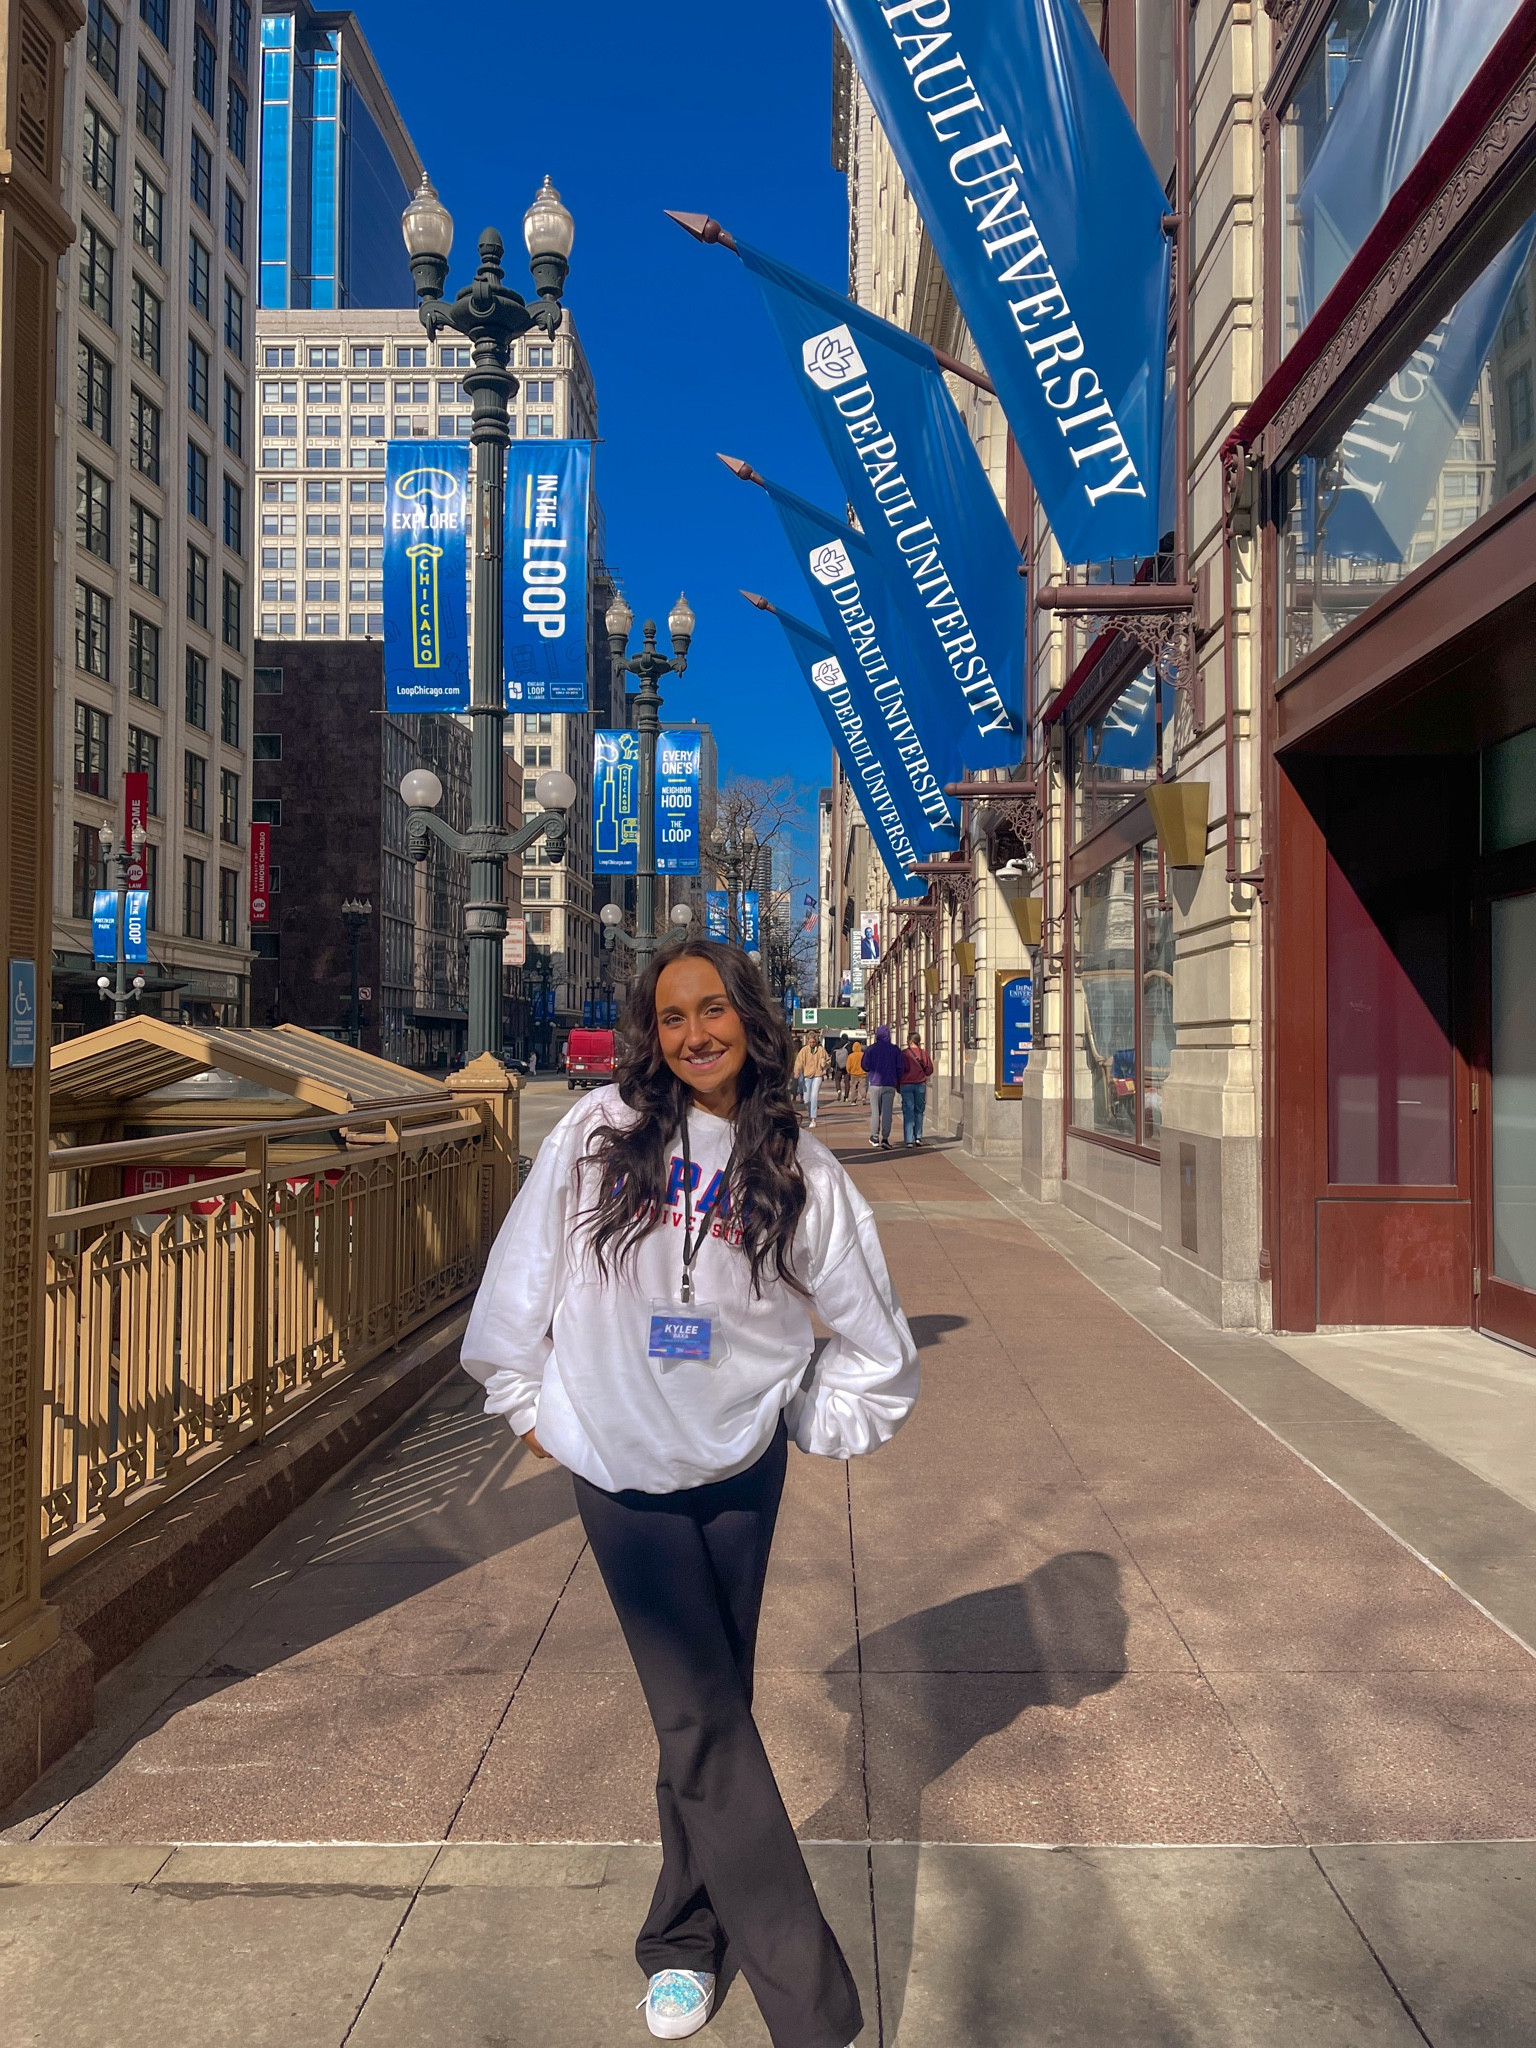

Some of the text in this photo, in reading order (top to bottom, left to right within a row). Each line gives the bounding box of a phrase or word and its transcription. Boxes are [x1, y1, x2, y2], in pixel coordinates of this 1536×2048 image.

[880, 0, 985, 142] PAUL
[949, 124, 1147, 507] UNIVERSITY
[392, 512, 457, 530] EXPLORE
[522, 474, 567, 639] IN THE LOOP
[419, 558, 433, 662] CHICAGO
[896, 516, 1014, 738] UNIVERSITY
[396, 684, 461, 697] LoopChicago.com
[527, 687, 545, 695] LOOP
[662, 750, 694, 762] EVERY
[873, 674, 955, 833] UNIVERSITY
[662, 761, 693, 775] ONE'S
[662, 786, 692, 794] NEIGHBOR
[661, 794, 692, 808] HOOD
[670, 820, 682, 828] THE
[662, 829, 692, 843] LOOP
[129, 917, 141, 945] LOOP
[664, 1324, 699, 1335] KYLEE
